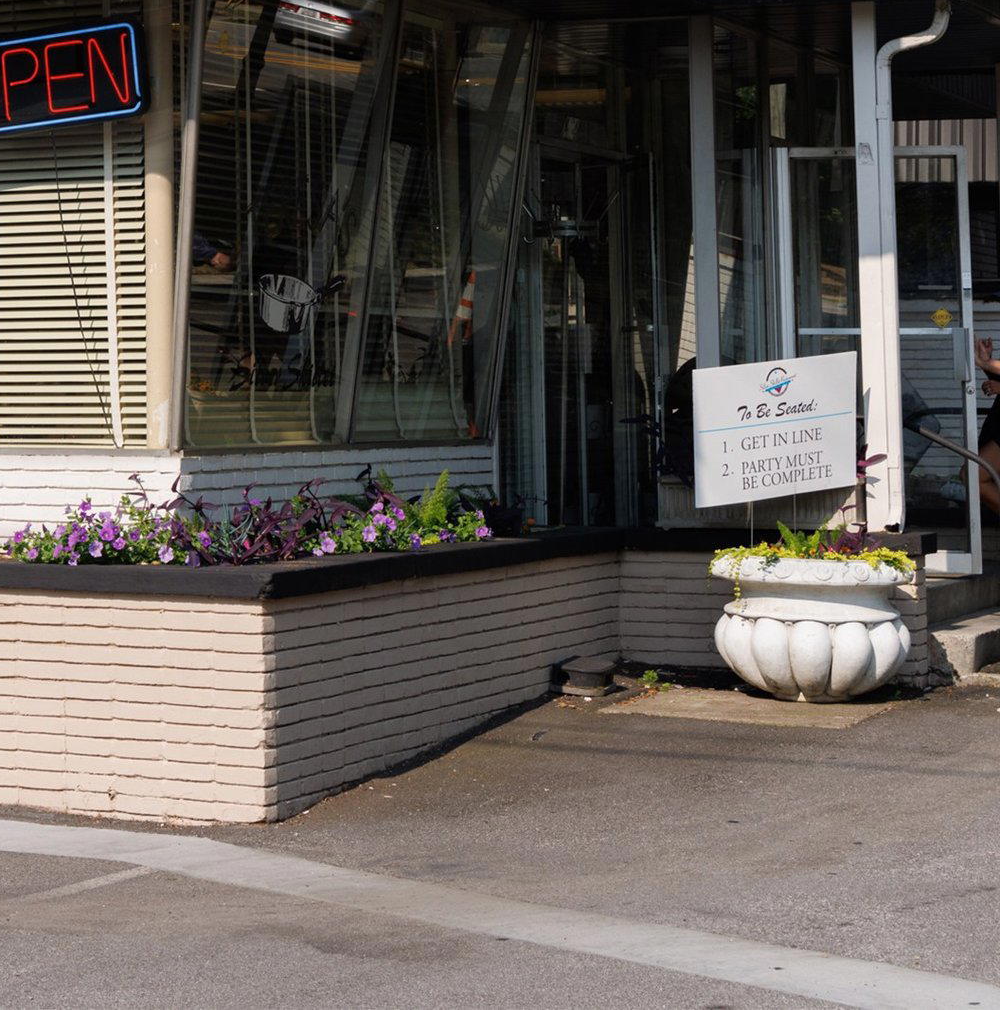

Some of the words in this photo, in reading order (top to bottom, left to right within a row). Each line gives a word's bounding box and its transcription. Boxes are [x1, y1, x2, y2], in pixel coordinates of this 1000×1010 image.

[737, 405, 752, 421] To
[757, 403, 771, 418] Be
[775, 399, 818, 417] Seated:
[722, 441, 734, 454] 1.
[740, 434, 770, 451] GET
[773, 432, 788, 447] IN
[792, 427, 823, 445] LINE
[722, 464, 734, 477] 2.
[741, 456, 783, 475] PARTY
[785, 451, 823, 469] MUST
[742, 477, 759, 490] BE
[761, 464, 833, 488] COMPLETE
